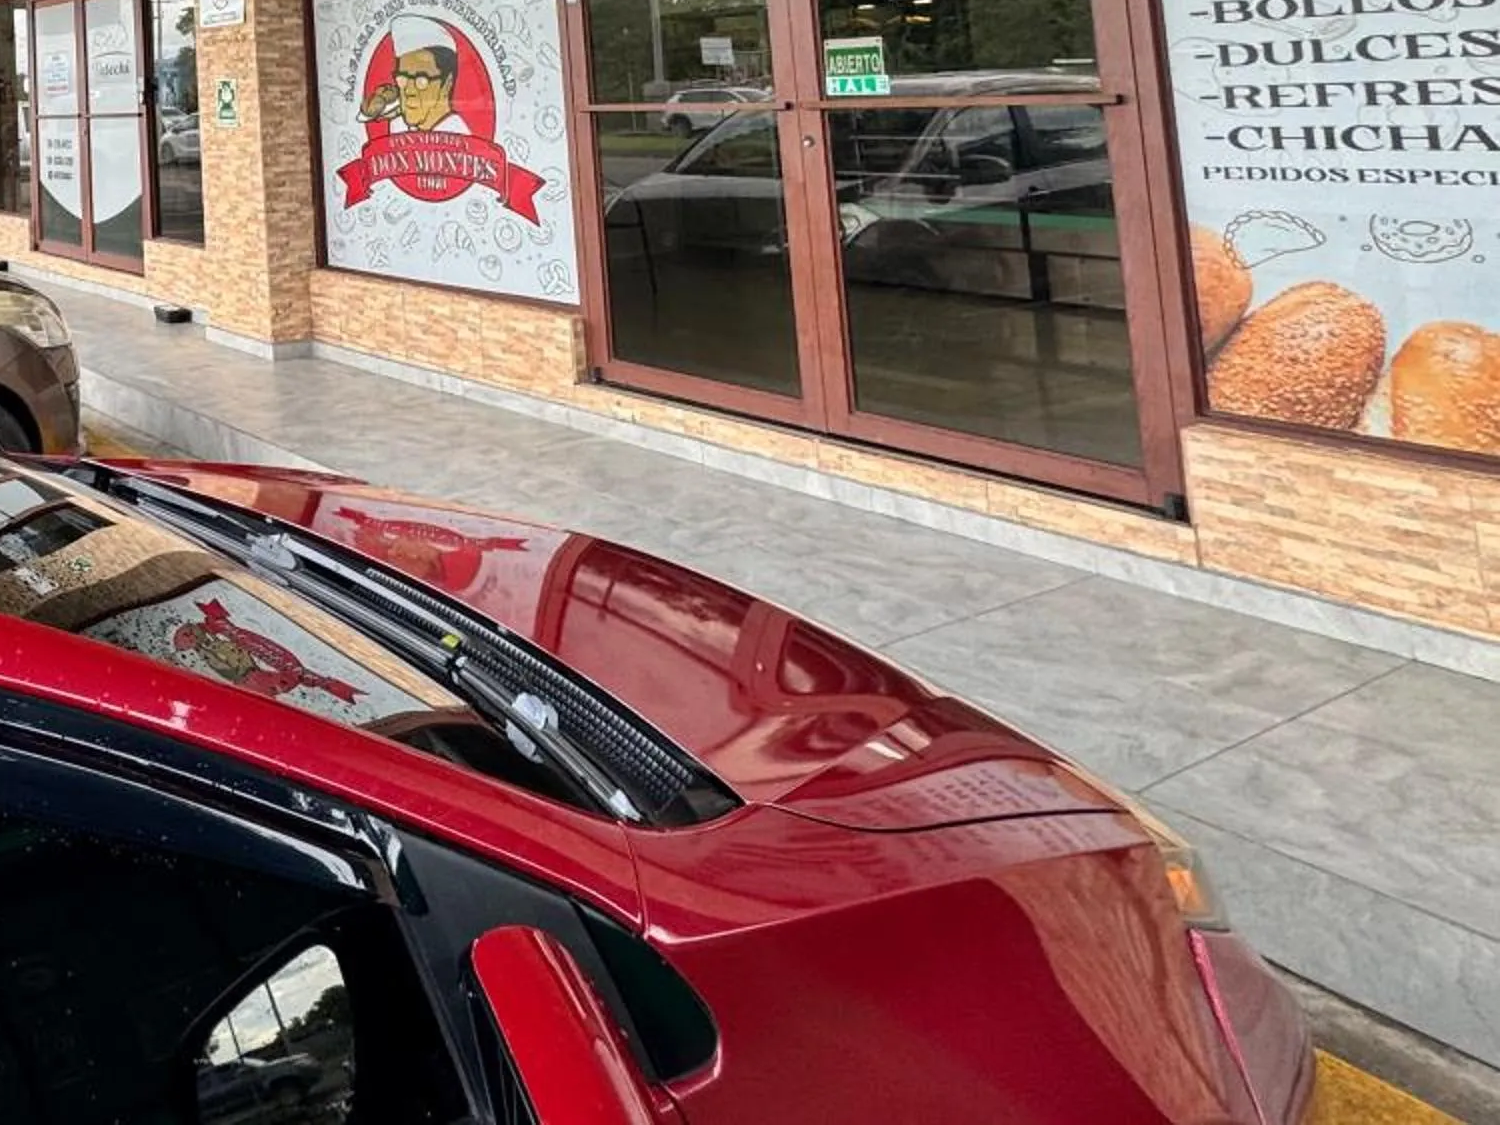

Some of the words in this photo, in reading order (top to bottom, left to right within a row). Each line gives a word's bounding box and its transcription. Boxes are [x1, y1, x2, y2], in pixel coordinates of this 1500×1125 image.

[829, 52, 881, 75] ABIERTO
[371, 150, 410, 176] DON
[414, 149, 498, 180] MONTES
[1203, 166, 1350, 183] PEDIDOS
